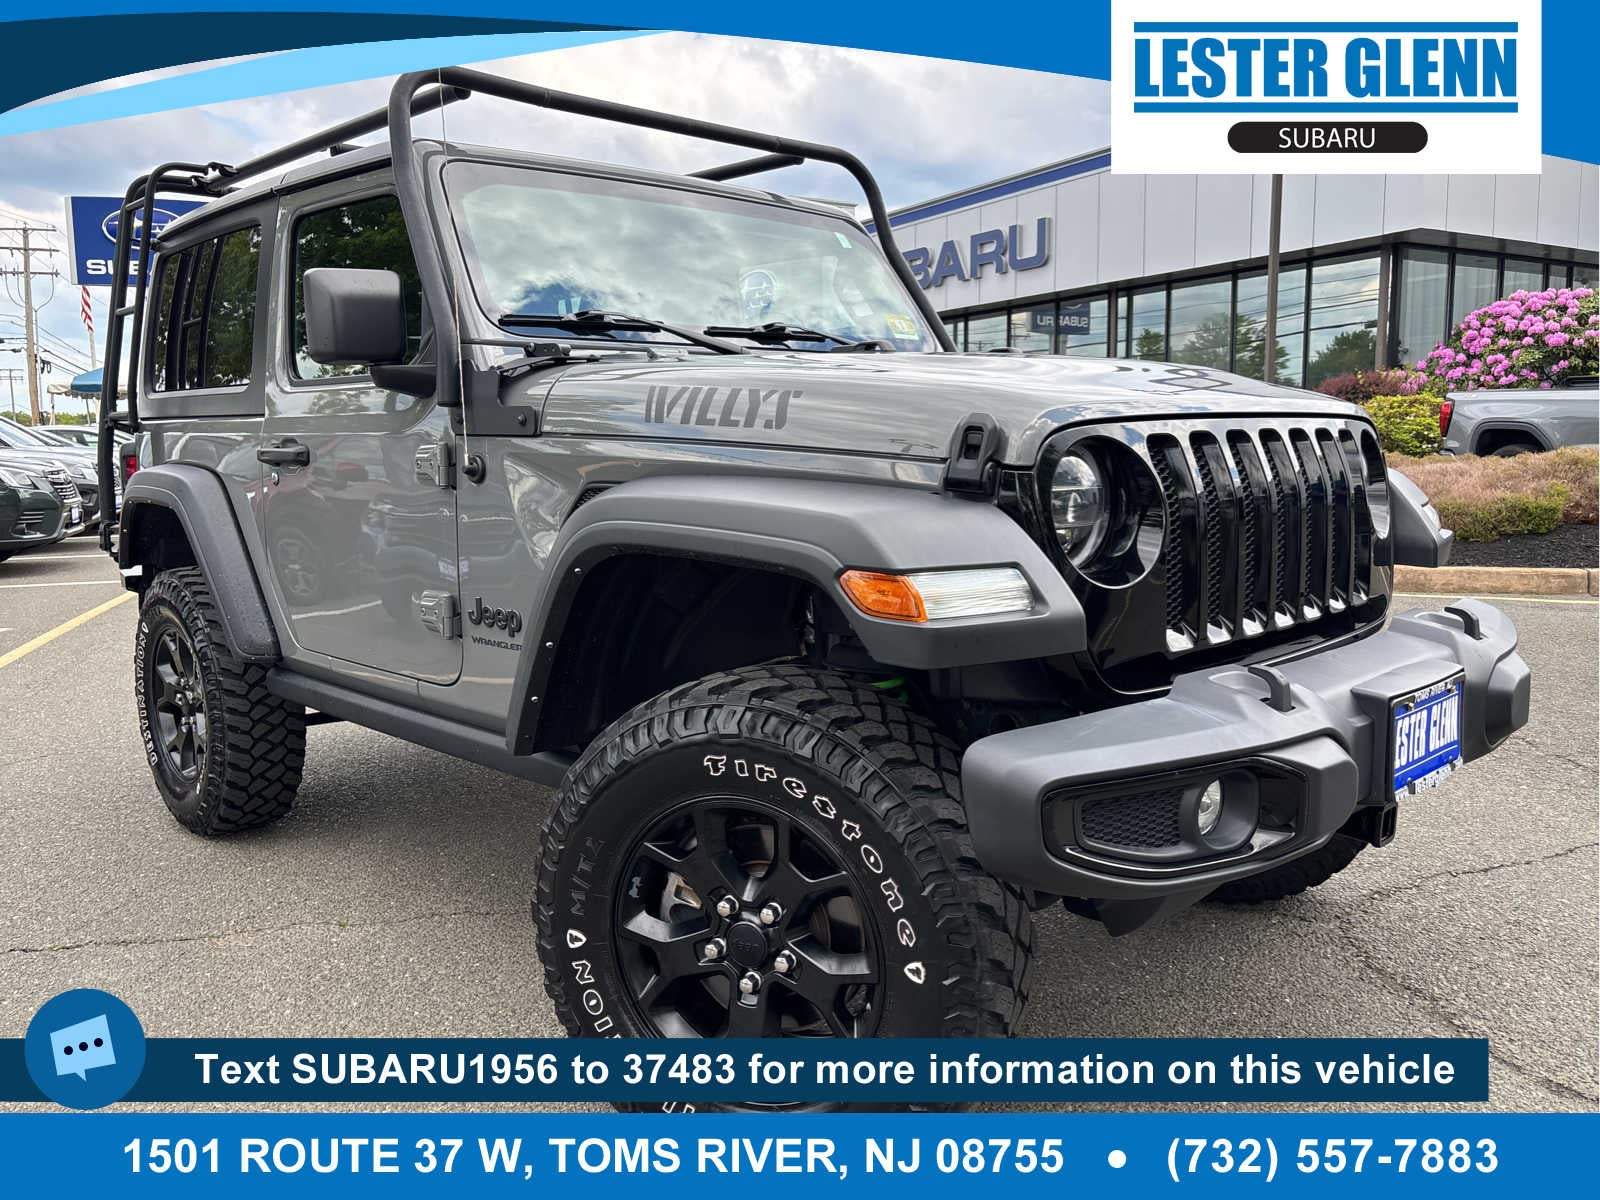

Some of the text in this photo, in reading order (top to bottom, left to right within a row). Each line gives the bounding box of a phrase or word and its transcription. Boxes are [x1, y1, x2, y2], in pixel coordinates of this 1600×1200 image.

[903, 217, 1049, 289] BARU
[644, 385, 804, 430] WILLYS
[467, 596, 522, 637] Jeep
[471, 635, 523, 651] WRANGLER
[1394, 694, 1459, 770] ESTER GLENN
[703, 755, 917, 948] Firestone
